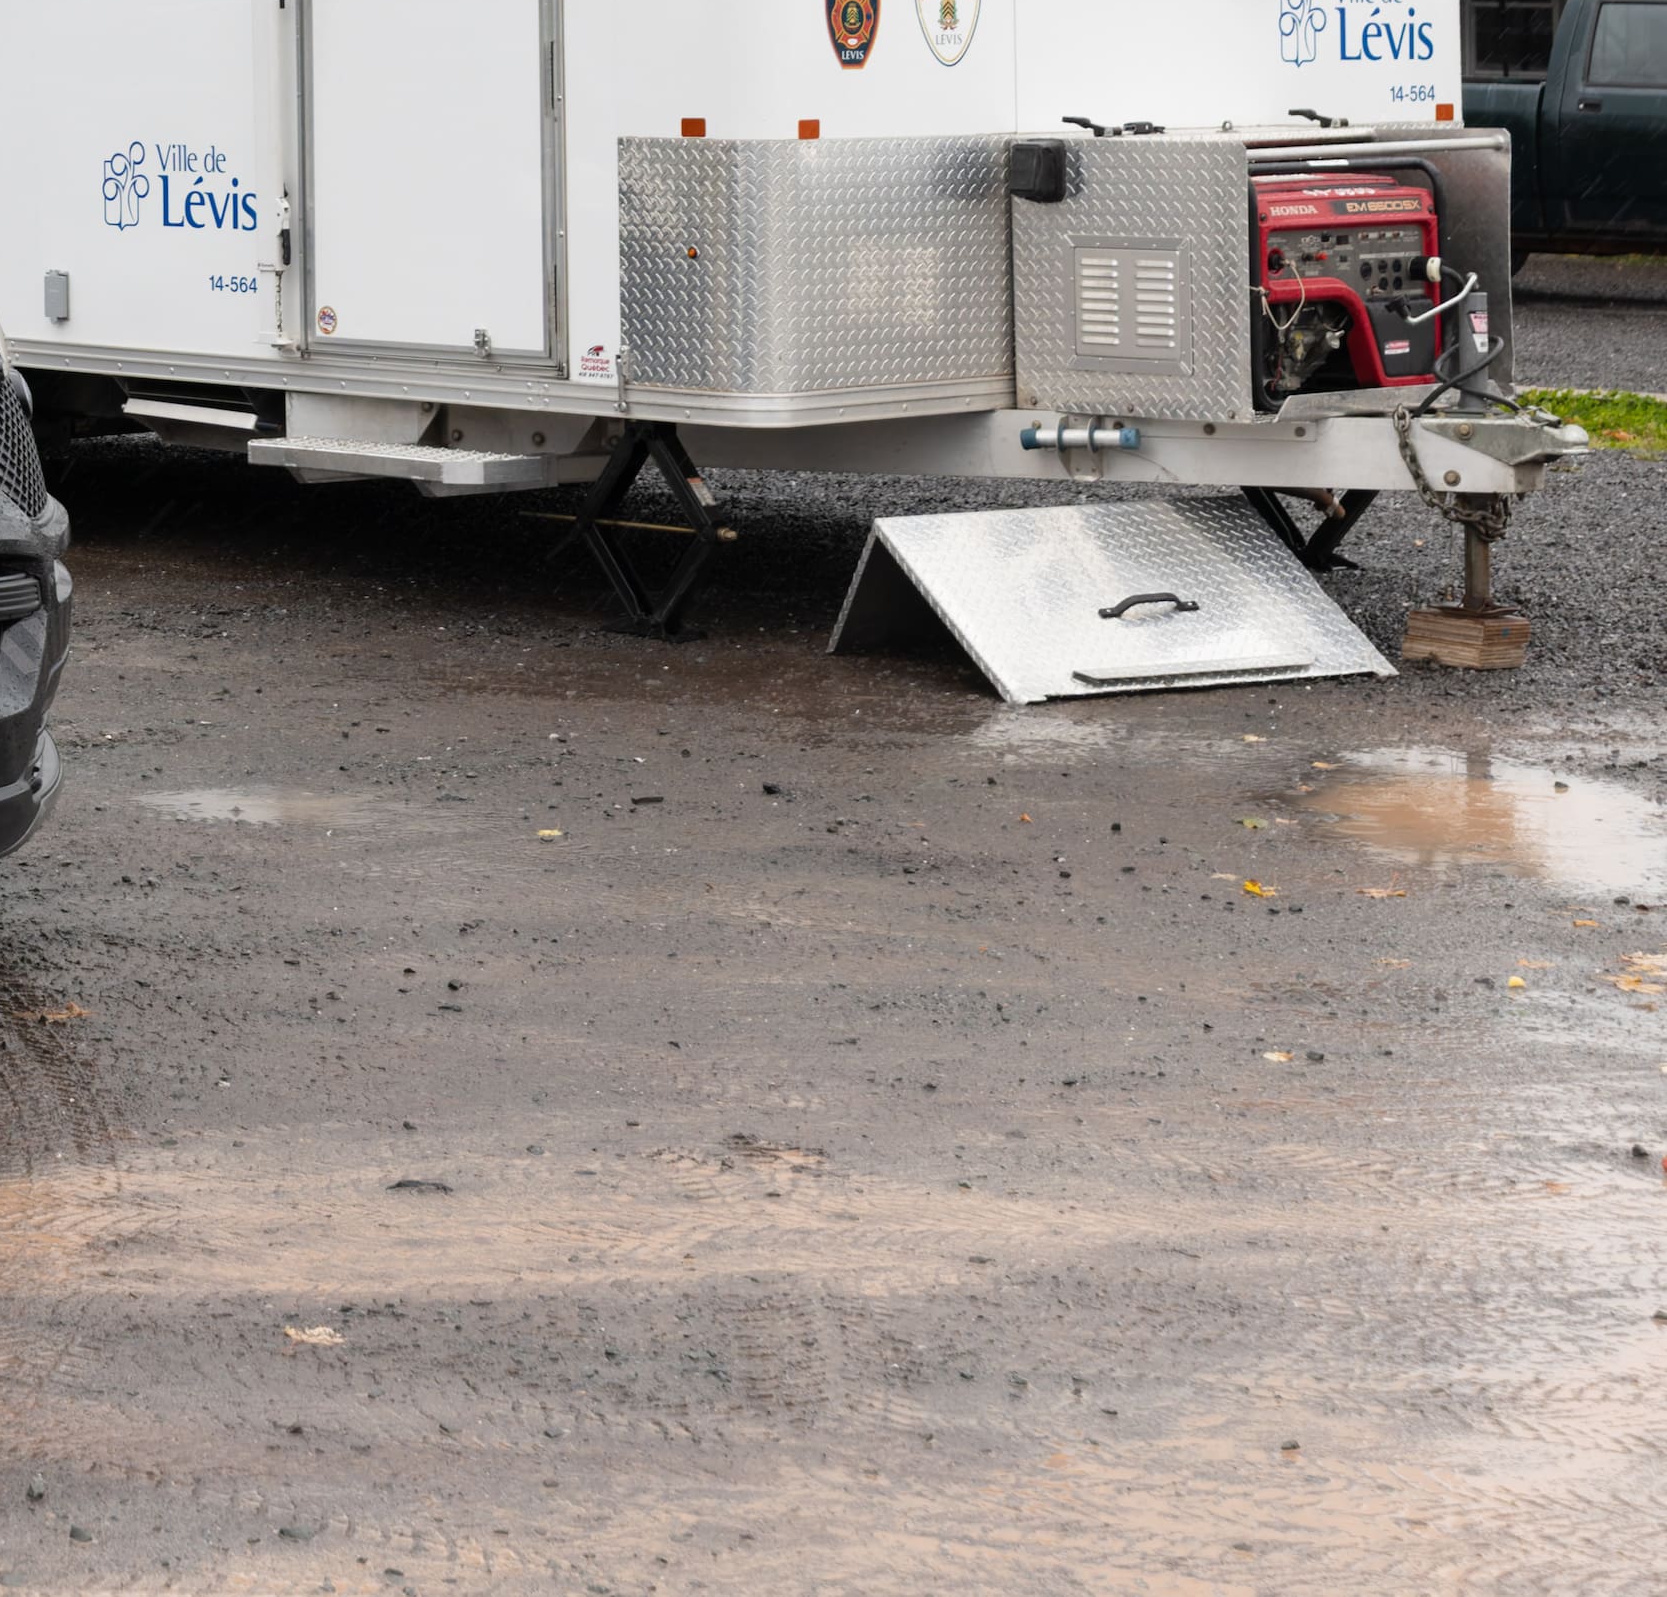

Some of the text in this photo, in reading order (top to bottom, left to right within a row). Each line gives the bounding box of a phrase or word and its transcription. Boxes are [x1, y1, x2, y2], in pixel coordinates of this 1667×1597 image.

[1335, 7, 1434, 61] Lévis
[1390, 84, 1436, 103] 14-564
[155, 144, 226, 173] Ville de
[158, 175, 257, 231] Lévis
[1270, 205, 1318, 216] HONDA
[209, 274, 257, 293] 14-564
